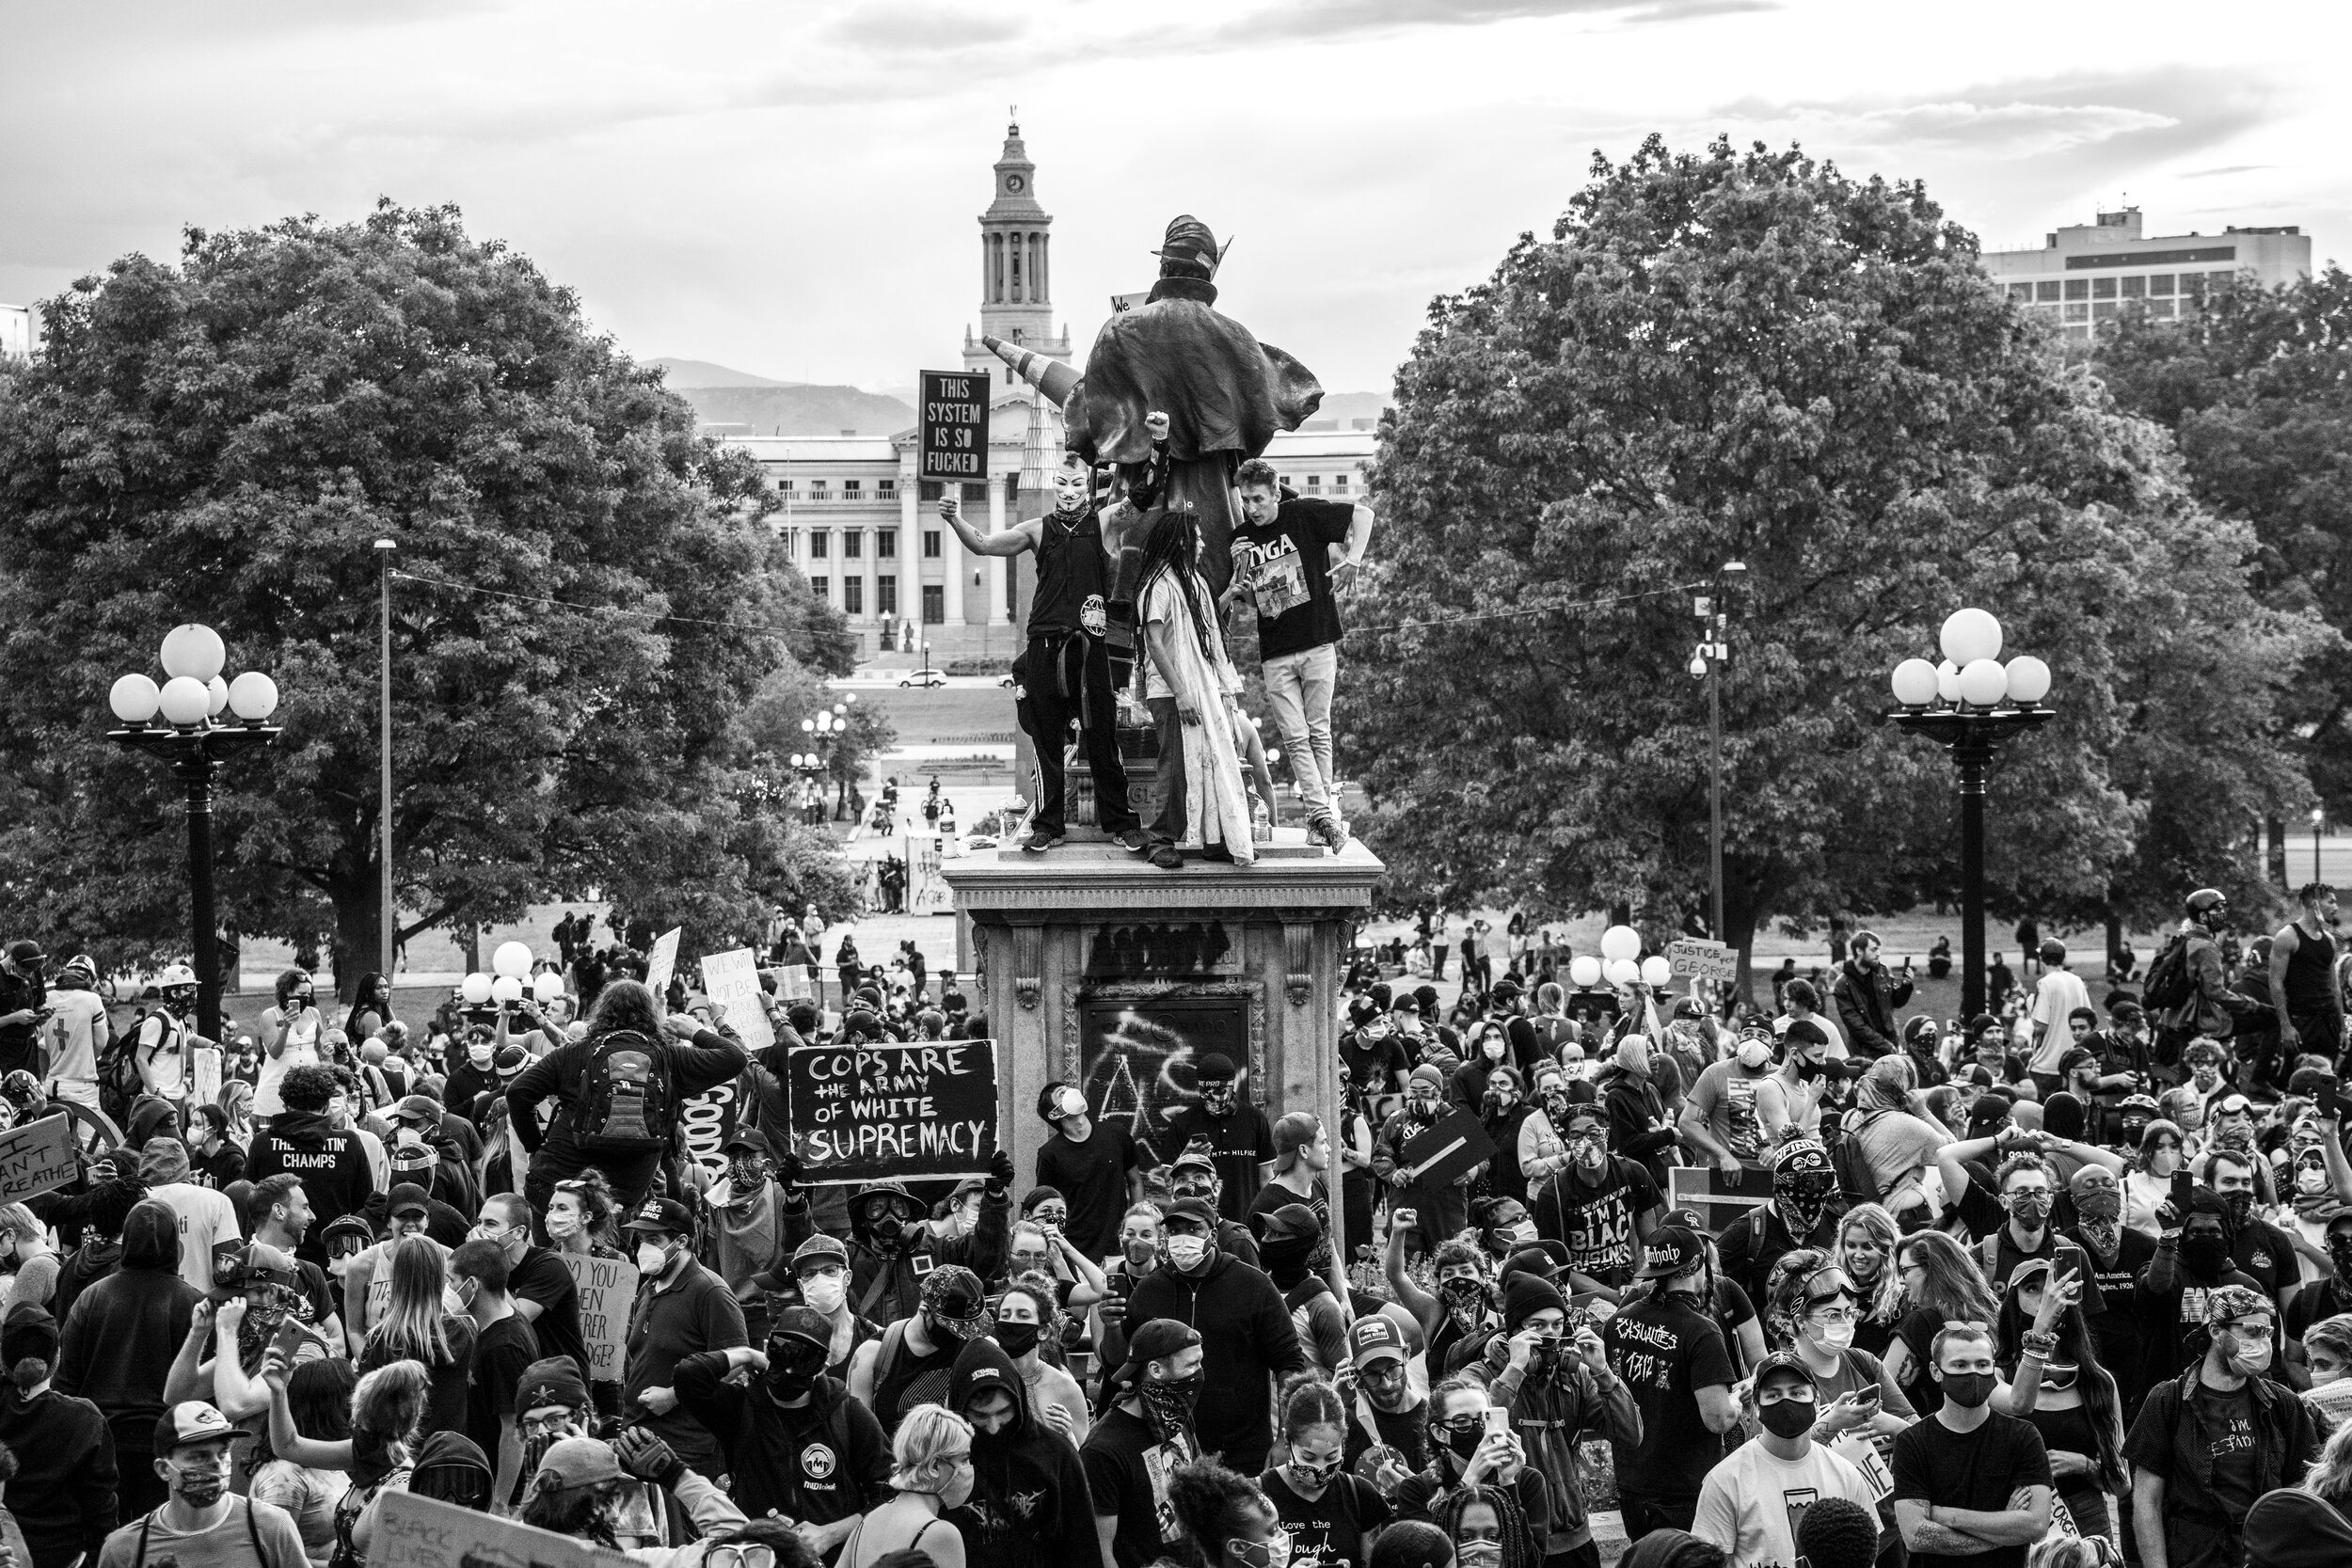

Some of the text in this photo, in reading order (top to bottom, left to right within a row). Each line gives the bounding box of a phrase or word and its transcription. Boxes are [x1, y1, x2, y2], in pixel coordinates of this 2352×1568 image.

[1111, 295, 1131, 313] We
[940, 378, 970, 399] THIS
[928, 402, 980, 423] SYSTEM
[935, 427, 973, 448] IS SO
[927, 451, 978, 473] FUCKED
[1673, 943, 1737, 965] JUSTICE FOR
[1675, 958, 1736, 978] GEORGE
[809, 1048, 975, 1080] COPS ARE
[859, 1074, 930, 1097] ARMY
[815, 1096, 939, 1122] OF WHITE
[808, 1119, 985, 1161] SUPREMACY
[283, 1154, 336, 1168] CHAMPS
[1584, 1198, 1626, 1228] I'M A
[1644, 1243, 1680, 1267] Unholy
[590, 1261, 618, 1289] YOU
[2097, 1283, 2119, 1291] ughes,
[1626, 1351, 1655, 1382] 1312
[1280, 1519, 1331, 1529] Love the
